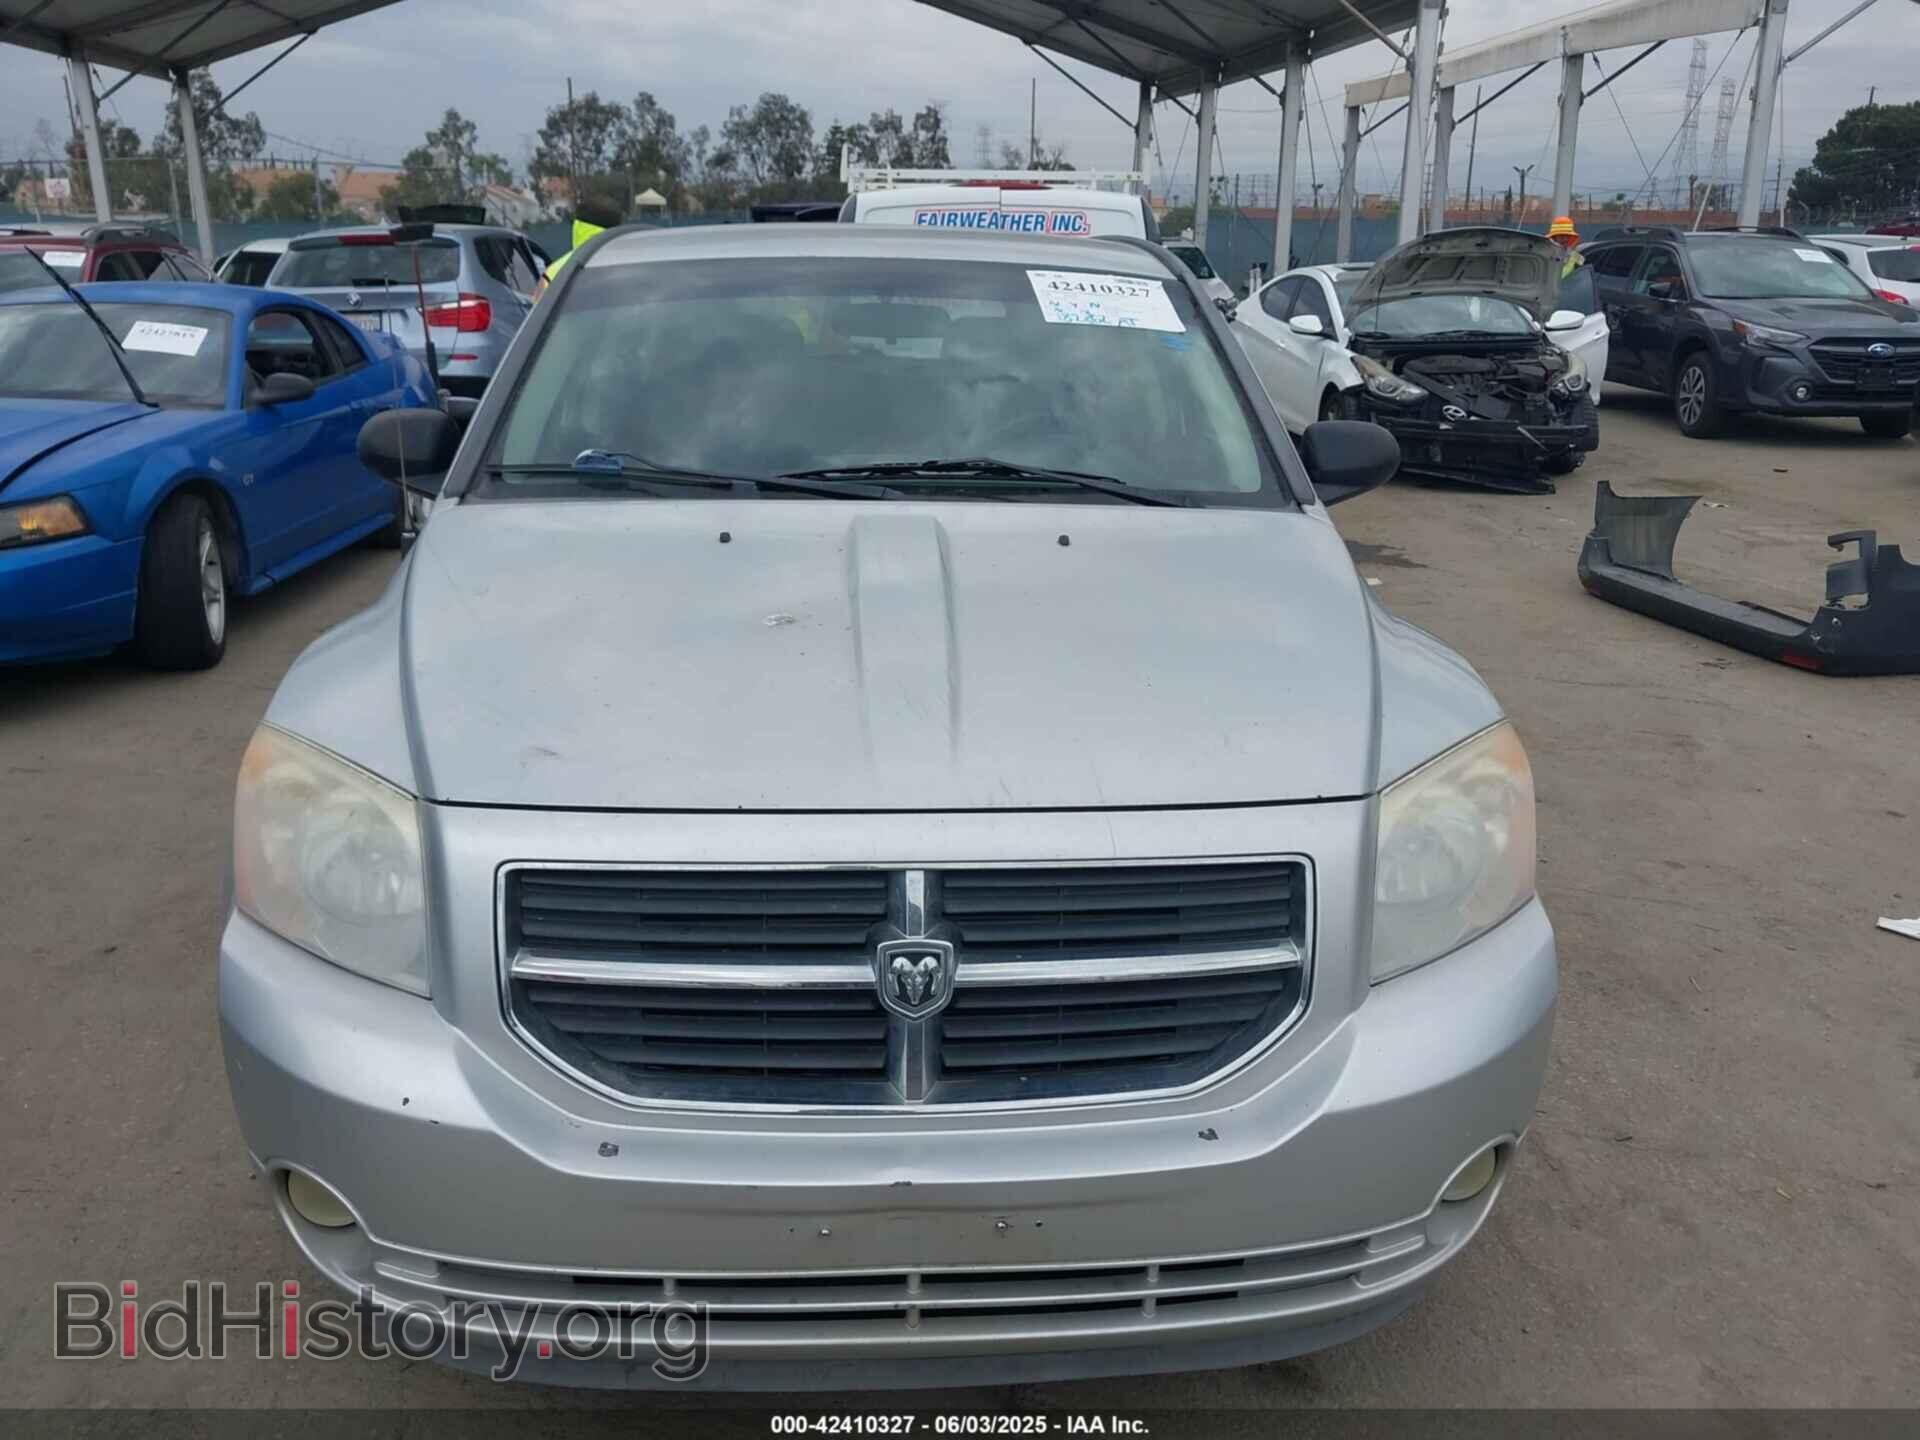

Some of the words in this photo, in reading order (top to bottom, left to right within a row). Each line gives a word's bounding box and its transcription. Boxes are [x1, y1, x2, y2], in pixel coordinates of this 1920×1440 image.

[916, 209, 1046, 231] FAIRWEATHER
[1051, 213, 1088, 233] INC.
[1048, 281, 1150, 298] 42410327
